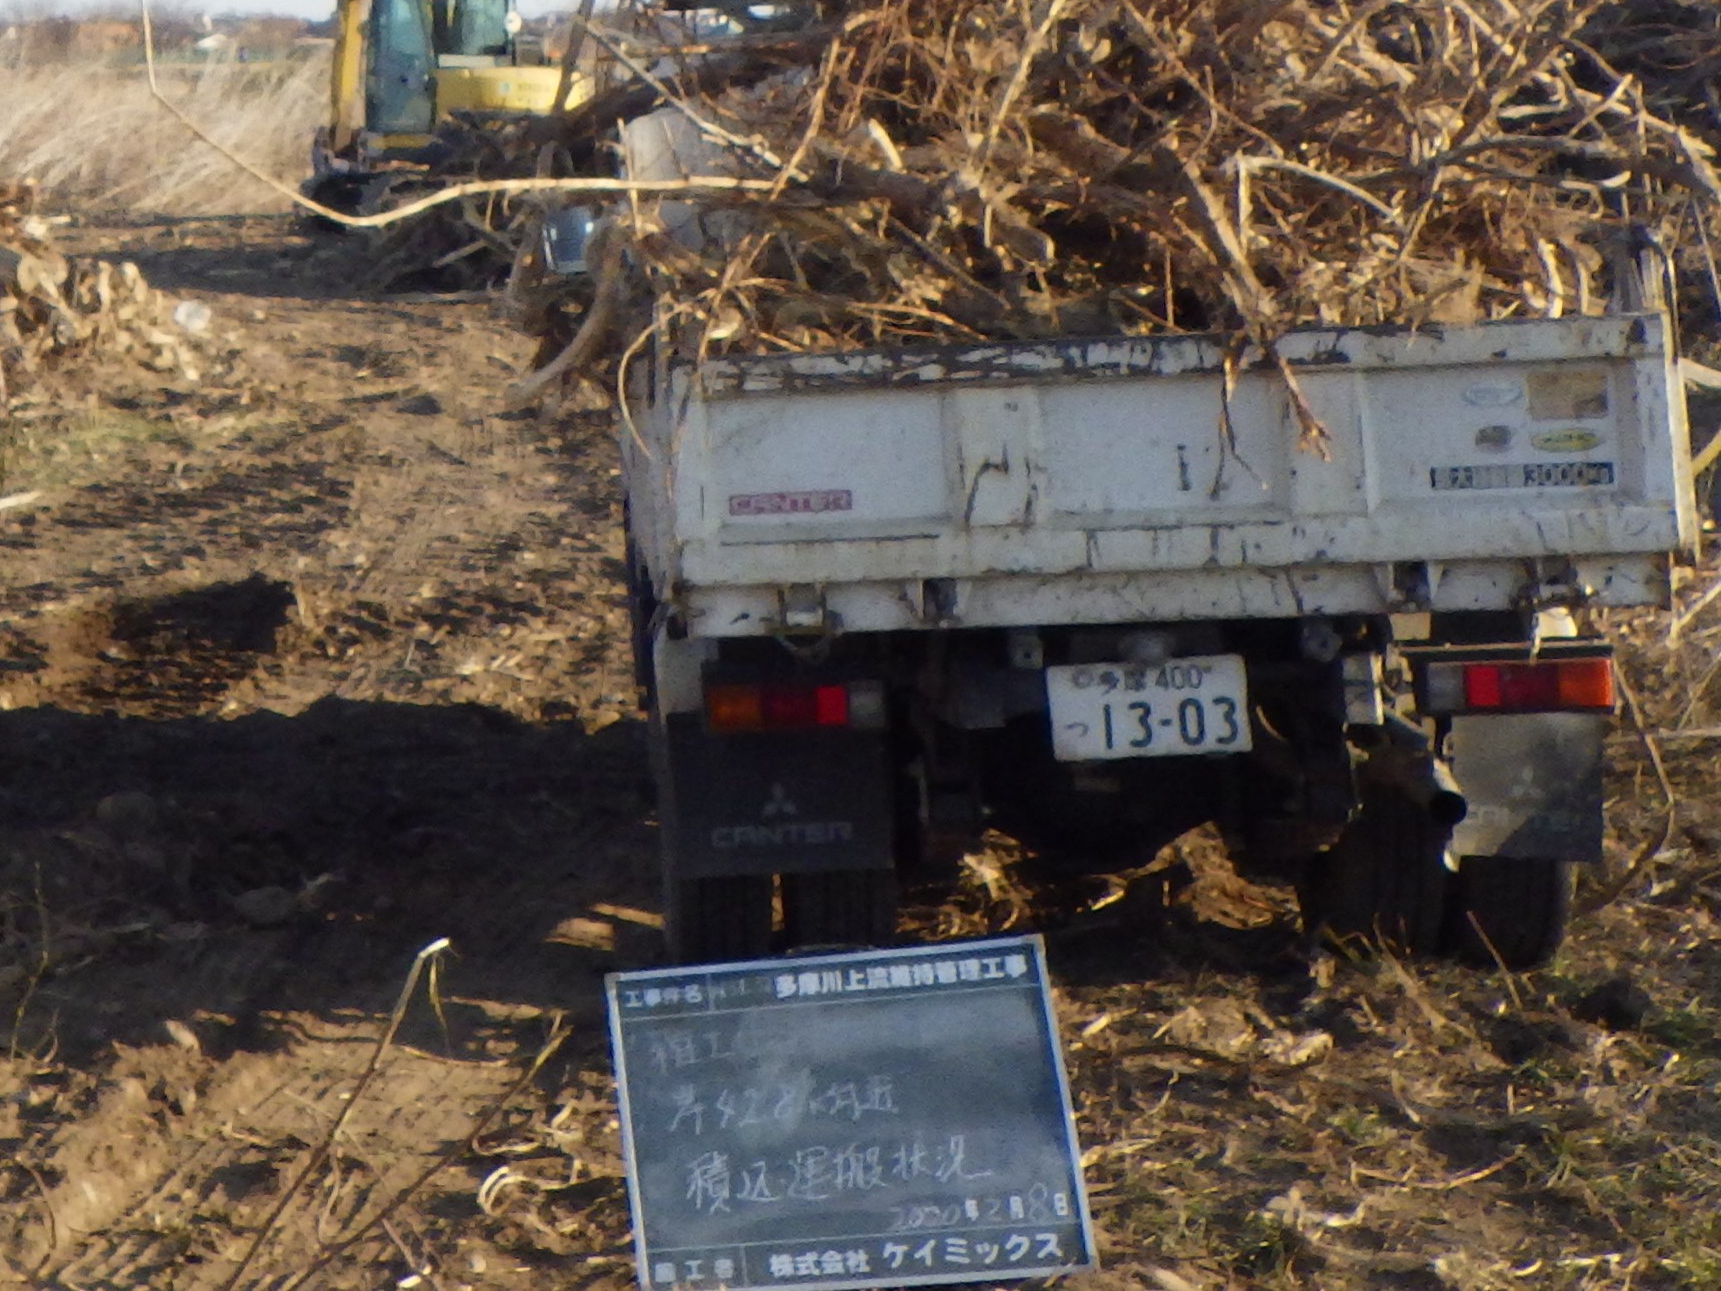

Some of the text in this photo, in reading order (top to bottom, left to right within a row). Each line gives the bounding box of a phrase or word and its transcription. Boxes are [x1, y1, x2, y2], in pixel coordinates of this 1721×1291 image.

[1102, 695, 1239, 750] 13-03
[770, 1249, 870, 1278] 株式会社
[882, 1232, 1063, 1268] ケイミックス
